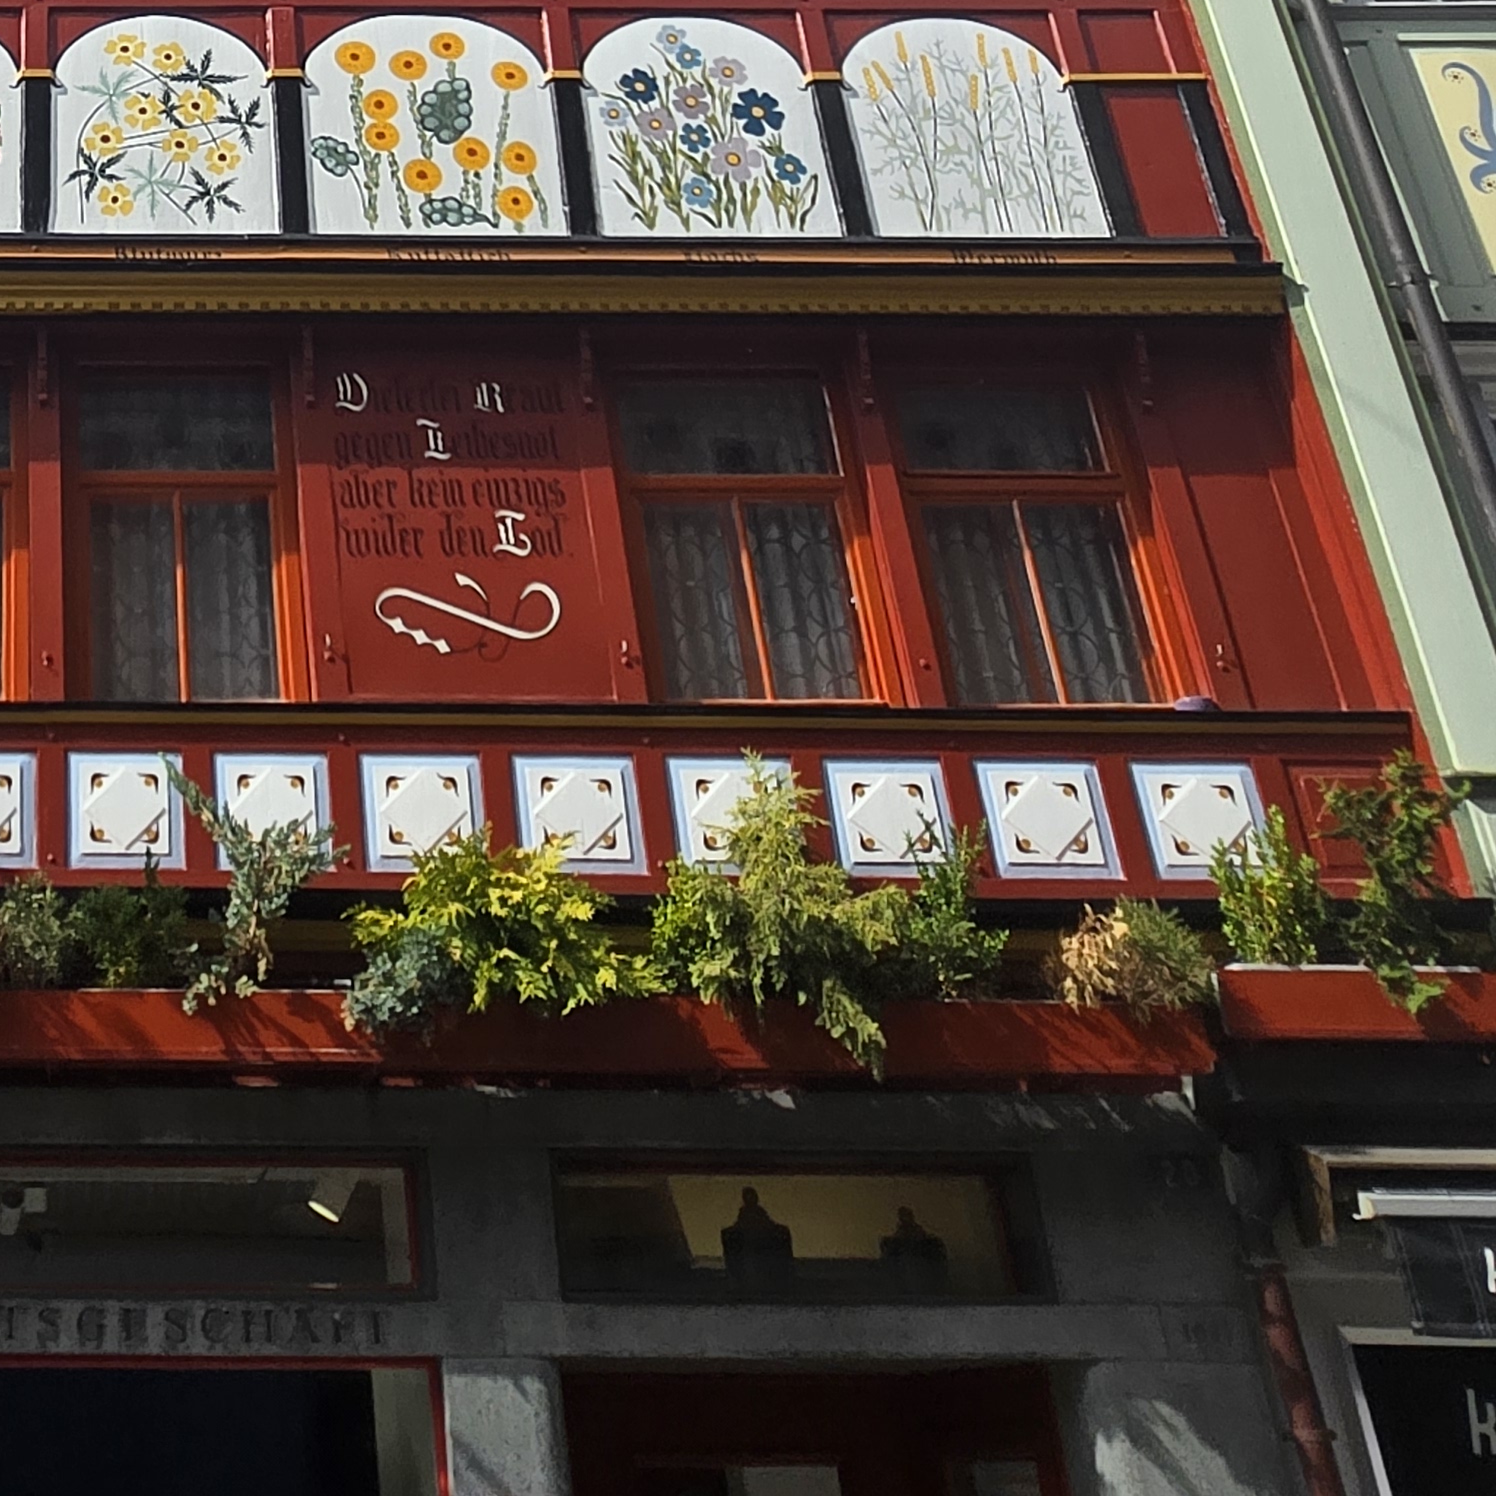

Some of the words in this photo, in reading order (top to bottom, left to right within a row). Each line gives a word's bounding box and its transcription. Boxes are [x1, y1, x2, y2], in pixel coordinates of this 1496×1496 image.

[334, 430, 414, 470] gegen
[340, 469, 398, 510] aber
[406, 466, 467, 509] kein
[338, 515, 425, 558] wider
[438, 509, 489, 558] den
